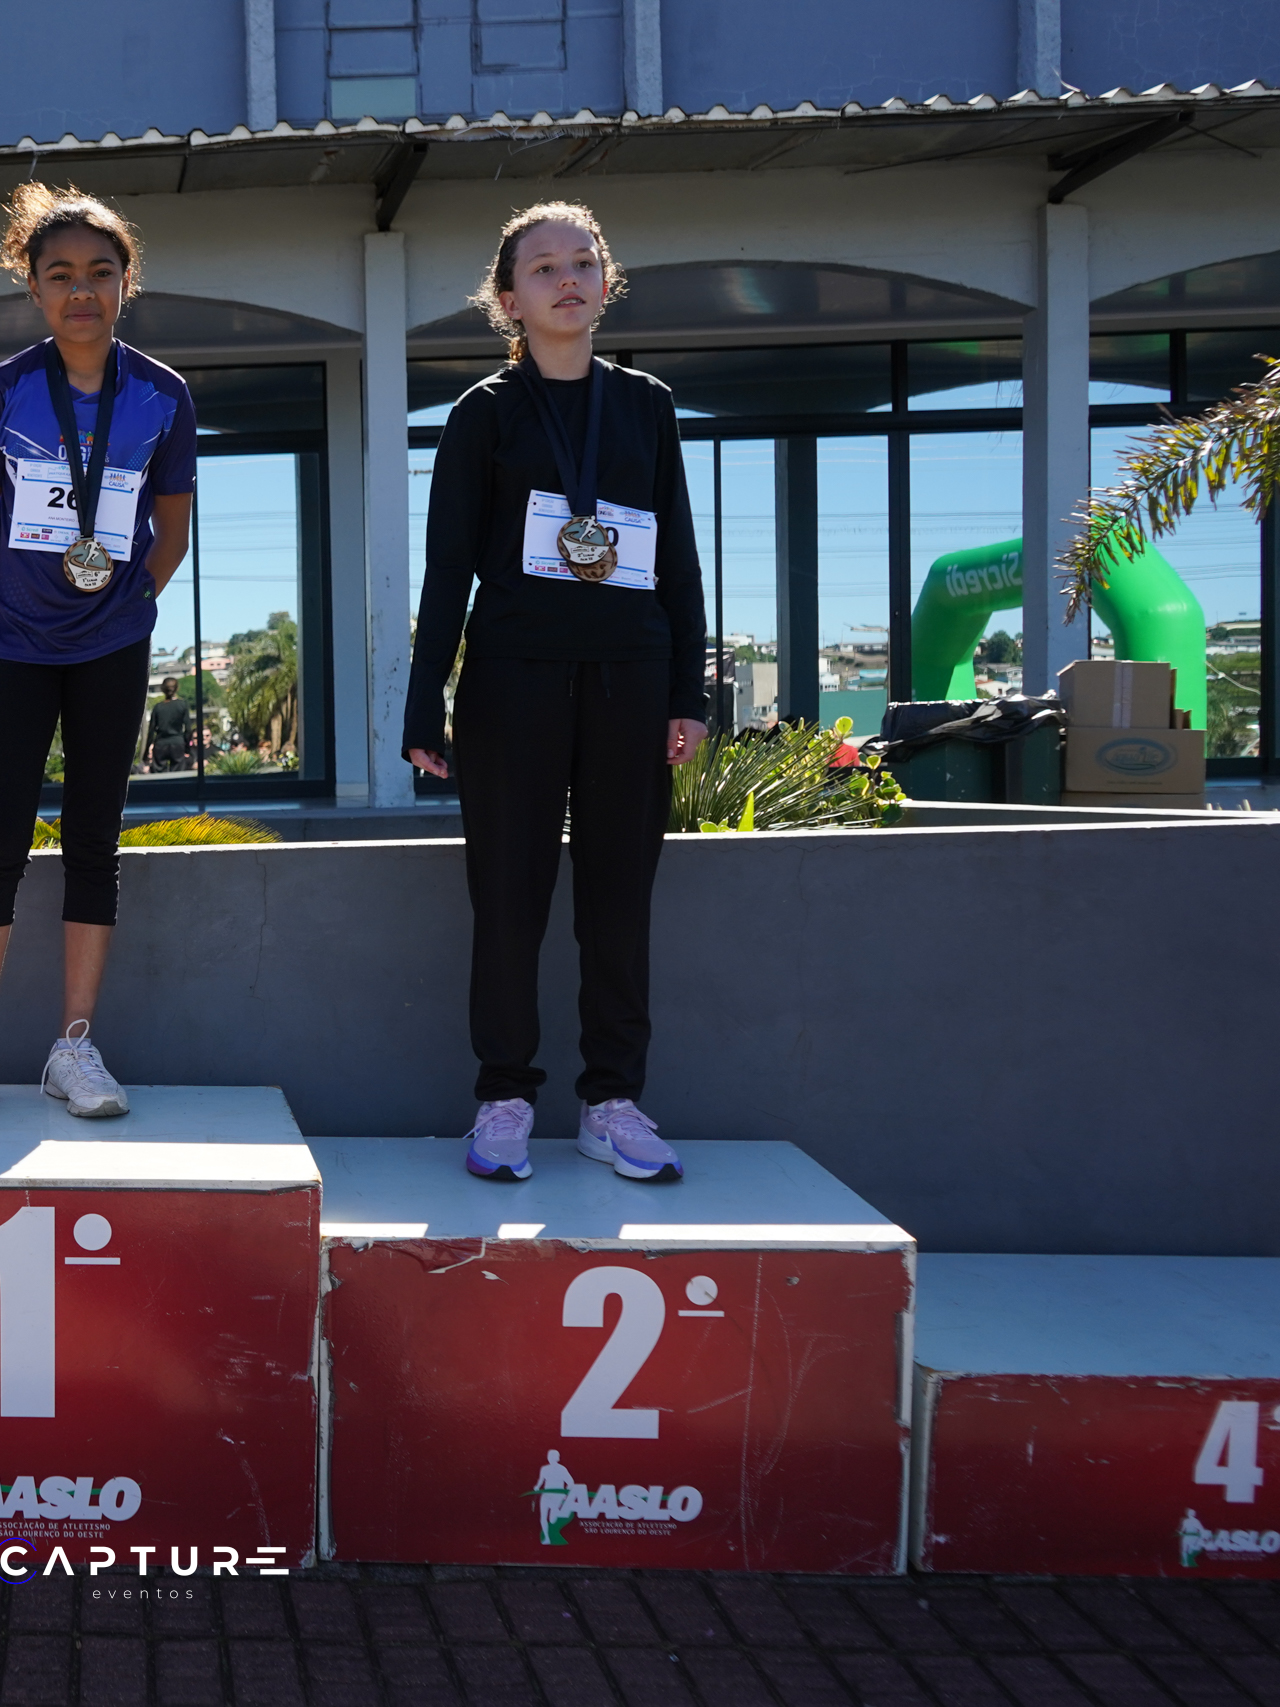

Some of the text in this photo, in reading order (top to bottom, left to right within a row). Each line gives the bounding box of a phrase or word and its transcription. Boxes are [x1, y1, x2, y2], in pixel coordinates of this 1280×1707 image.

[556, 1483, 703, 1522] AASLO
[48, 1522, 59, 1530] DE
[62, 1523, 111, 1531] ATLETISMO
[637, 1522, 677, 1530] ATLETISMO
[18, 1530, 60, 1539] LOURENÇO
